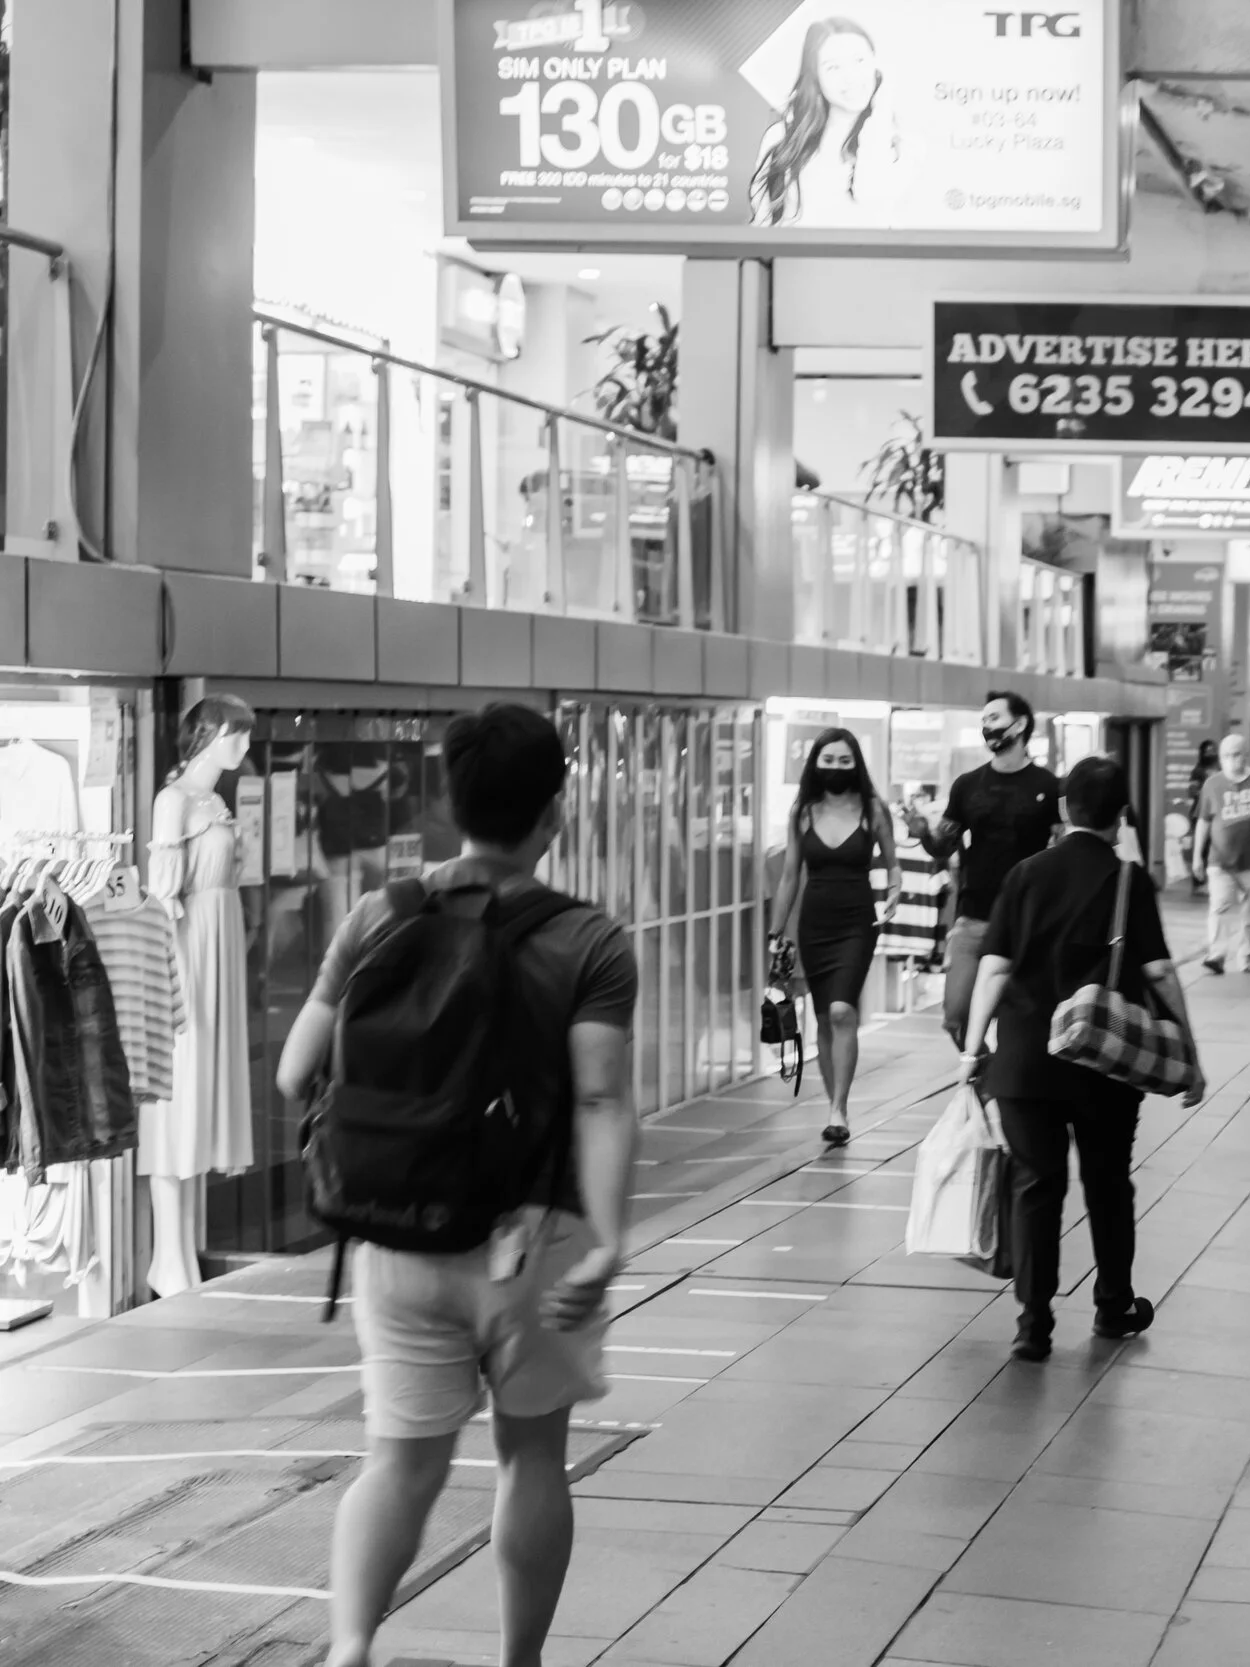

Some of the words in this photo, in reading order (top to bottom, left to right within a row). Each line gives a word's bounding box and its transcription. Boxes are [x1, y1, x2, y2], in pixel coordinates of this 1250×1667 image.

[983, 12, 1081, 37] TPG
[498, 56, 540, 80] SIM
[543, 56, 604, 80] ONLY
[607, 56, 667, 80] PLAN
[933, 81, 984, 106] Sign
[991, 87, 1020, 105] up
[1026, 82, 1082, 104] now!
[949, 130, 1006, 153] Lucky
[1012, 132, 1065, 150] Plaza
[658, 152, 682, 169] for
[947, 332, 1178, 367] ADVERTISE
[1007, 373, 1135, 416] 6235
